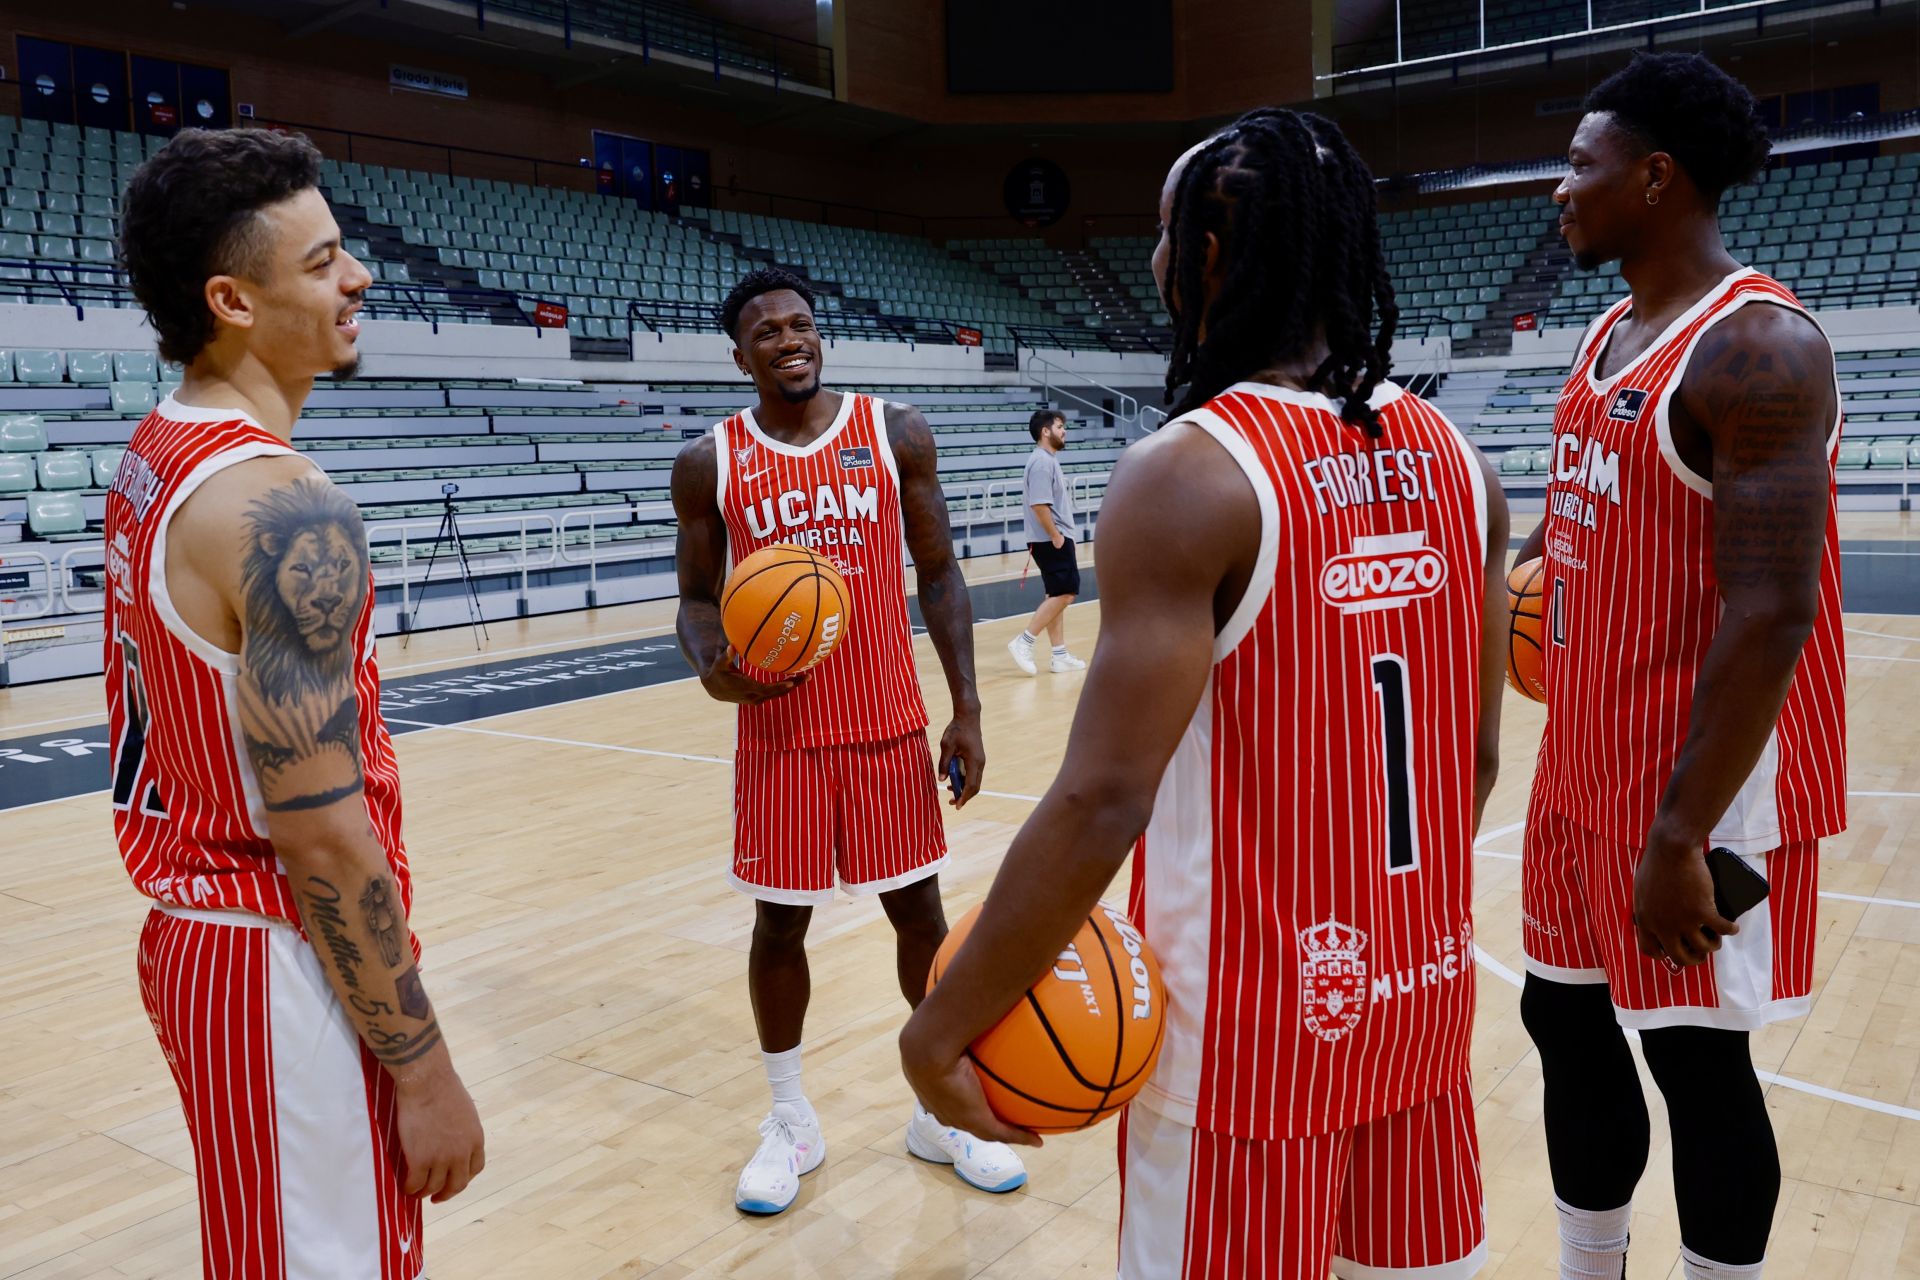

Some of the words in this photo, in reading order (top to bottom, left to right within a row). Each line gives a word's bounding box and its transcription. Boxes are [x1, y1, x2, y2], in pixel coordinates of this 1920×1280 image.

[1303, 449, 1436, 515] FORREST
[744, 484, 878, 539] UCAM
[1552, 491, 1597, 532] URCIA
[379, 645, 677, 700] yuntamiento
[441, 660, 658, 697] Murcia
[1370, 652, 1420, 876] 1
[303, 876, 363, 992] Matthew
[348, 992, 408, 1045] 5:8
[1097, 899, 1151, 1020] ilson
[1080, 984, 1101, 1017] NXT
